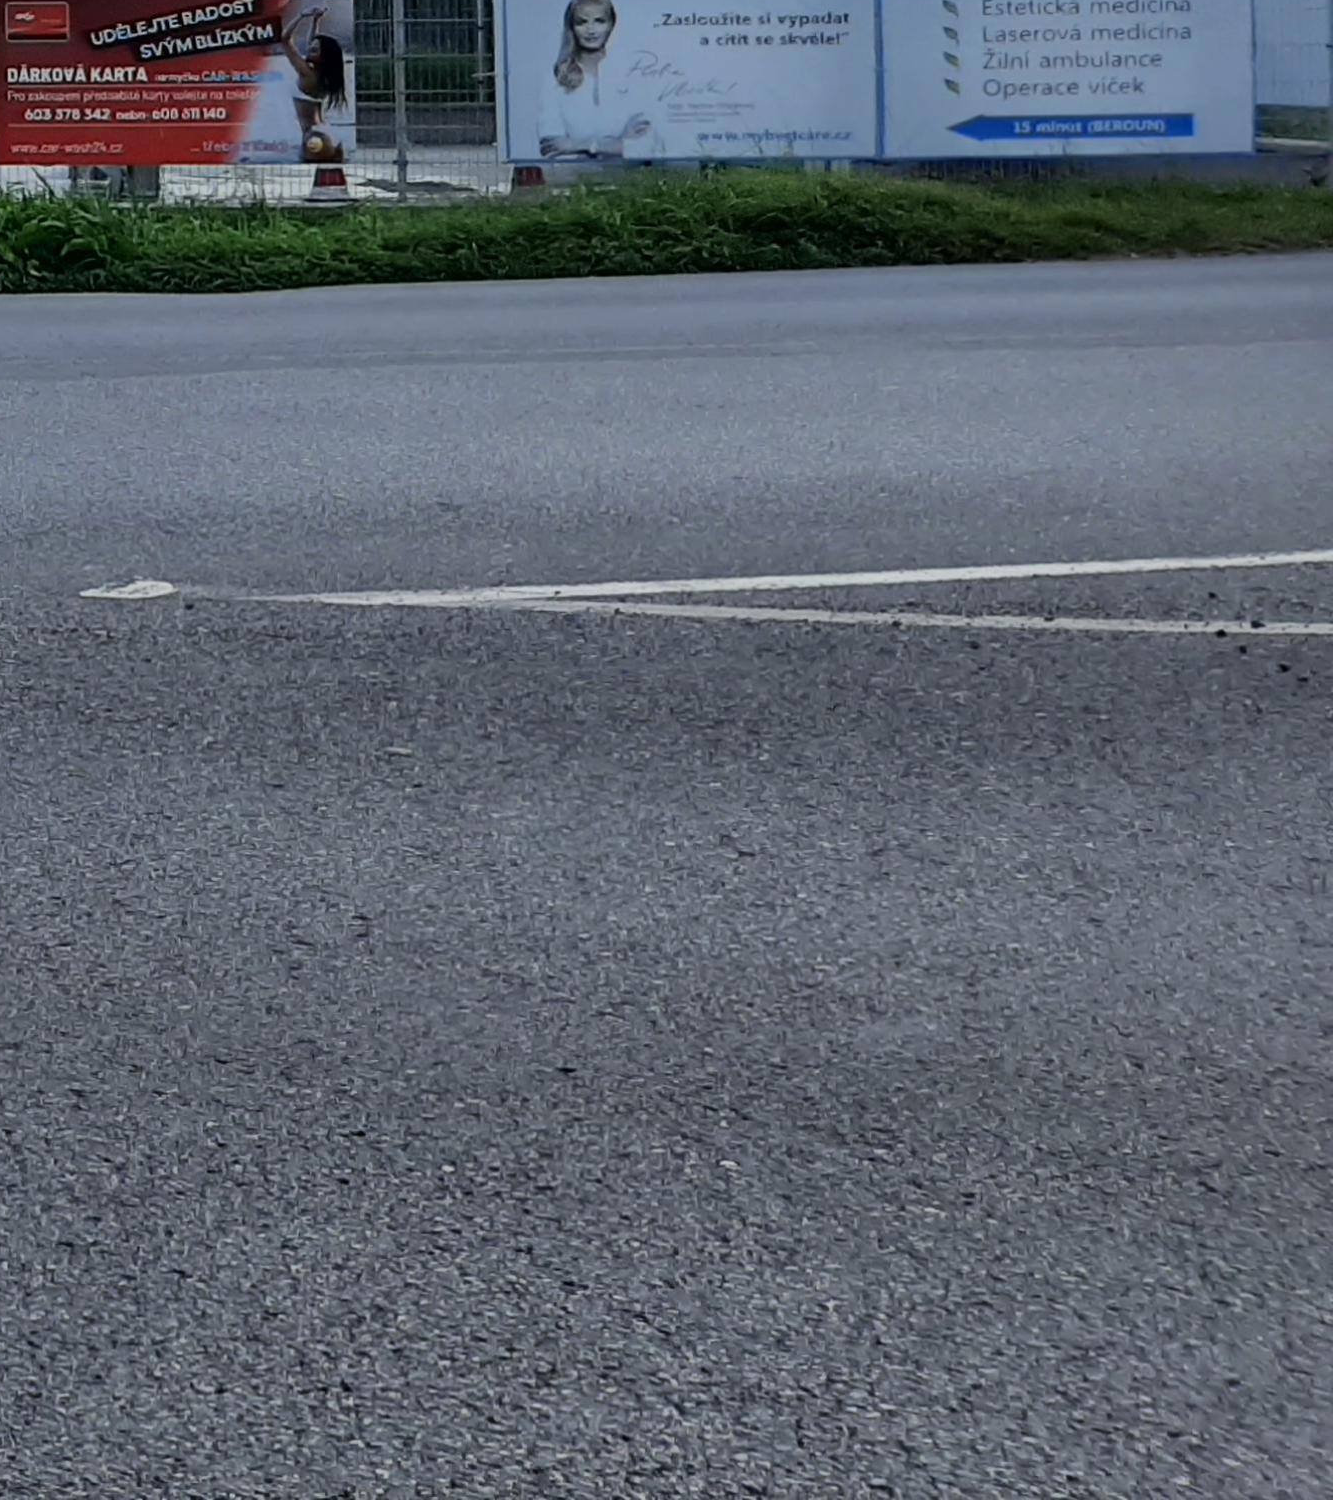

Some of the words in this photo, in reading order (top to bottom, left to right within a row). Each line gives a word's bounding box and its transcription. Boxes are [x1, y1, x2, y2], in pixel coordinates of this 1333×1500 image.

[90, 14, 181, 46] UDĚLEJTE
[758, 11, 771, 25] si
[777, 11, 850, 28] vypadat
[139, 36, 194, 60] SVÝM
[194, 23, 274, 50] BLÍZKÝM
[699, 35, 710, 46] a
[755, 35, 774, 46] se
[982, 23, 1082, 43] Laserová
[1090, 21, 1193, 41] medicína
[982, 48, 1030, 70] Žilní
[1039, 50, 1164, 69] ambulance
[7, 64, 87, 83] DÁRKOVÁ
[90, 67, 149, 83] KARTA
[982, 78, 1080, 99] Operace
[1087, 75, 1146, 95] víček
[1013, 121, 1031, 134] 15
[1036, 120, 1082, 133] minut
[1087, 119, 1166, 134] (BEROUN)
